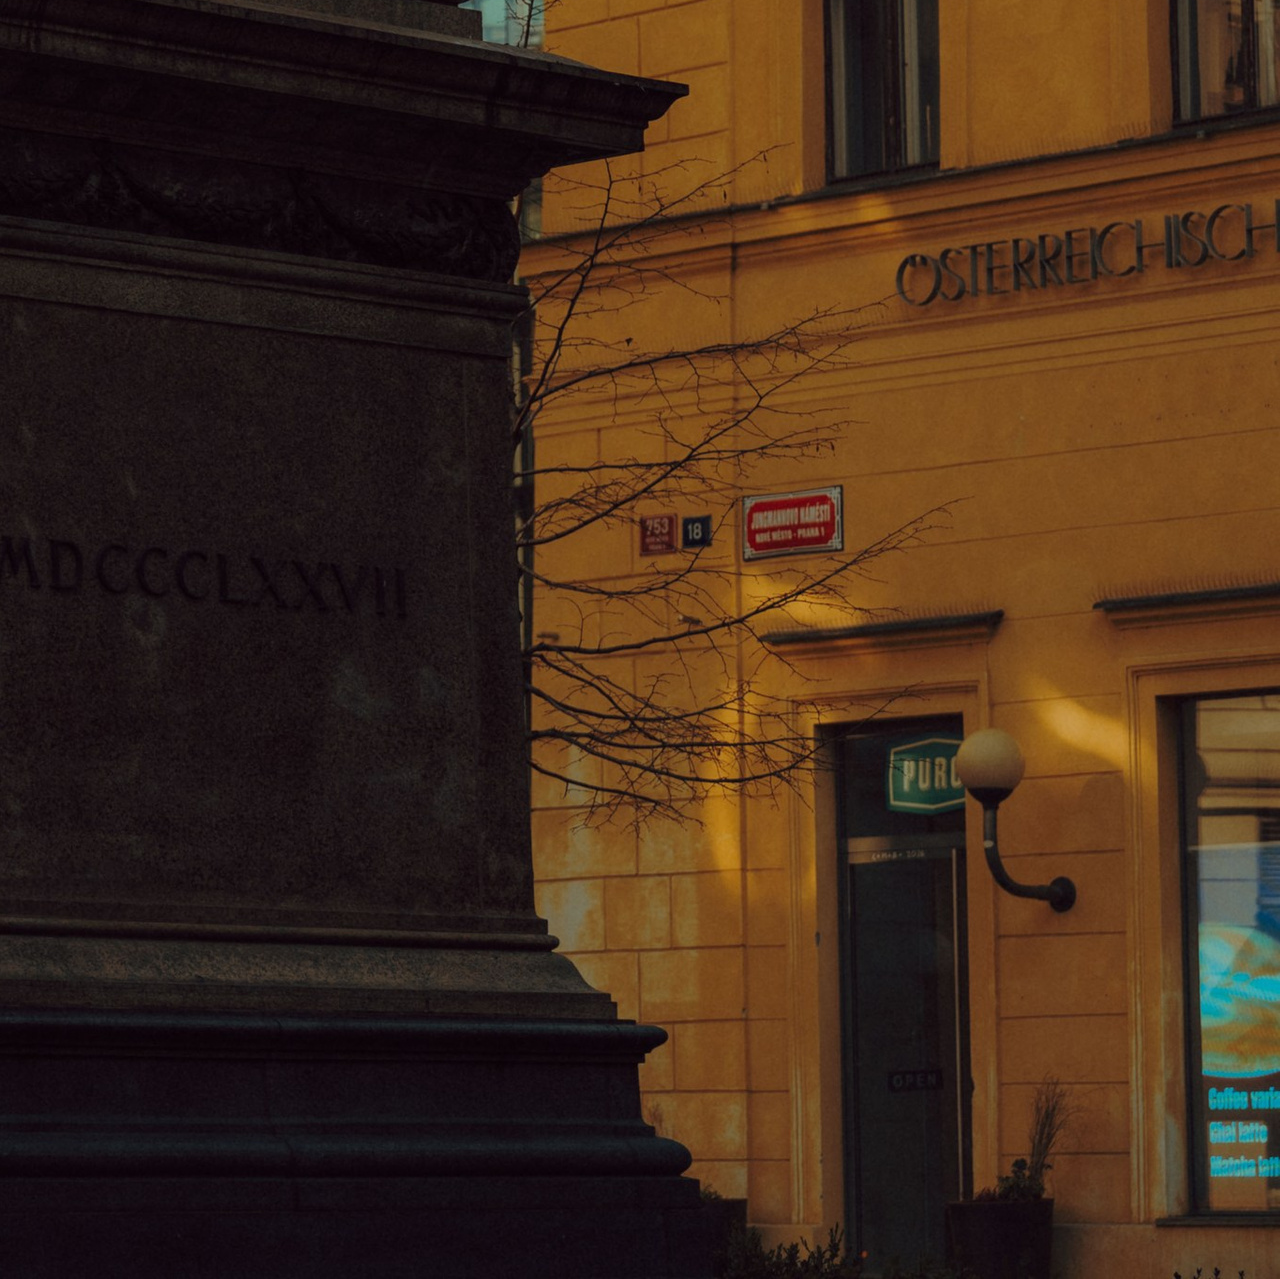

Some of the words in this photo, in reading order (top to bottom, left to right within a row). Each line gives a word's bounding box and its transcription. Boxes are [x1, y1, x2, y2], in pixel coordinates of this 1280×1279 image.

[687, 522, 703, 540] 18
[892, 1073, 937, 1088] OPEN
[1208, 1087, 1248, 1110] Coffee
